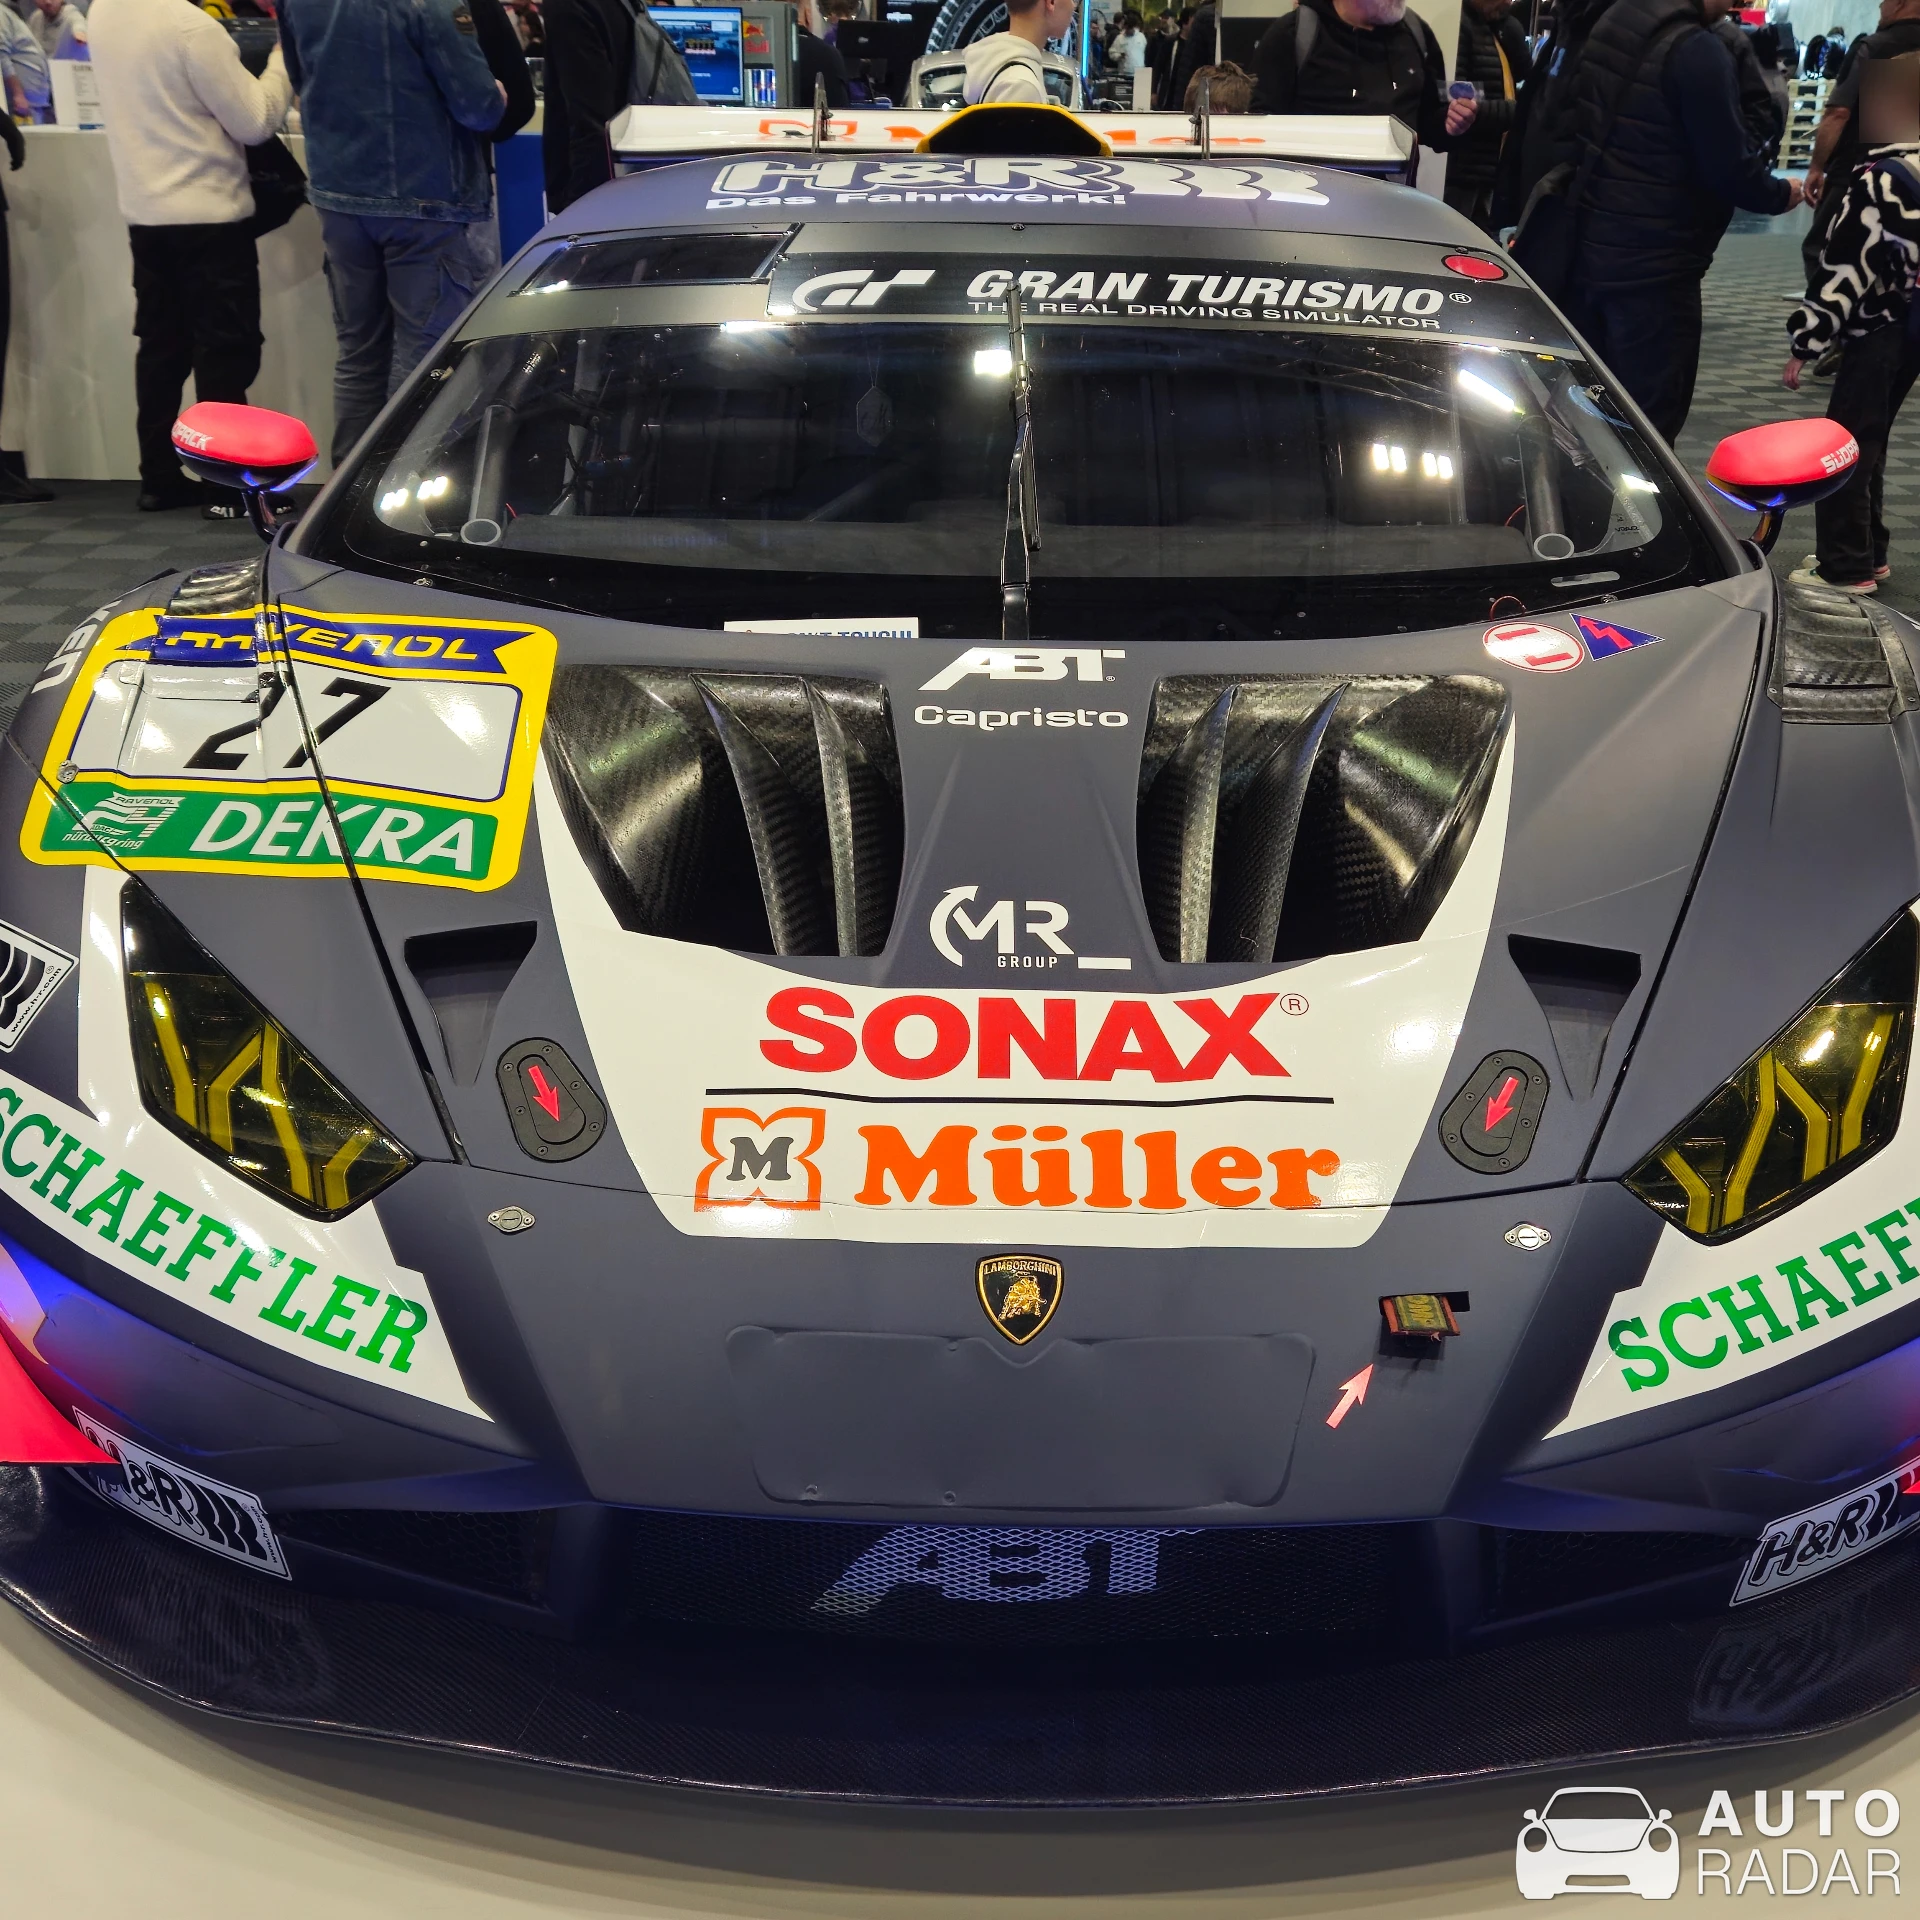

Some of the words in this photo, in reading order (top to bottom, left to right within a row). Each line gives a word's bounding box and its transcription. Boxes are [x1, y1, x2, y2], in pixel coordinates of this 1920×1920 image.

[711, 158, 1120, 195] H&R
[705, 197, 816, 210] Das
[835, 191, 1126, 205] Fahrwerk!
[966, 269, 1148, 300] GRAN
[1166, 274, 1444, 315] TURISMO
[968, 301, 1027, 314] THE
[1039, 303, 1117, 314] REAL
[1127, 304, 1252, 319] DRIVING
[1262, 309, 1441, 330] SIMULATOR
[917, 646, 1126, 691] ABT
[183, 674, 392, 770] 27
[914, 705, 1129, 731] Capristo
[188, 800, 475, 873] DEKRA
[997, 956, 1058, 968] GROUP
[10, 967, 62, 1033] www.h-r.com
[725, 1136, 795, 1182] M
[853, 1124, 1341, 1209] Müller
[984, 1260, 1057, 1277] LAMBORGHINI
[1607, 1196, 1920, 1393] SCHAEF
[1748, 1494, 1876, 1587] H&R
[810, 1525, 1203, 1614] ABT
